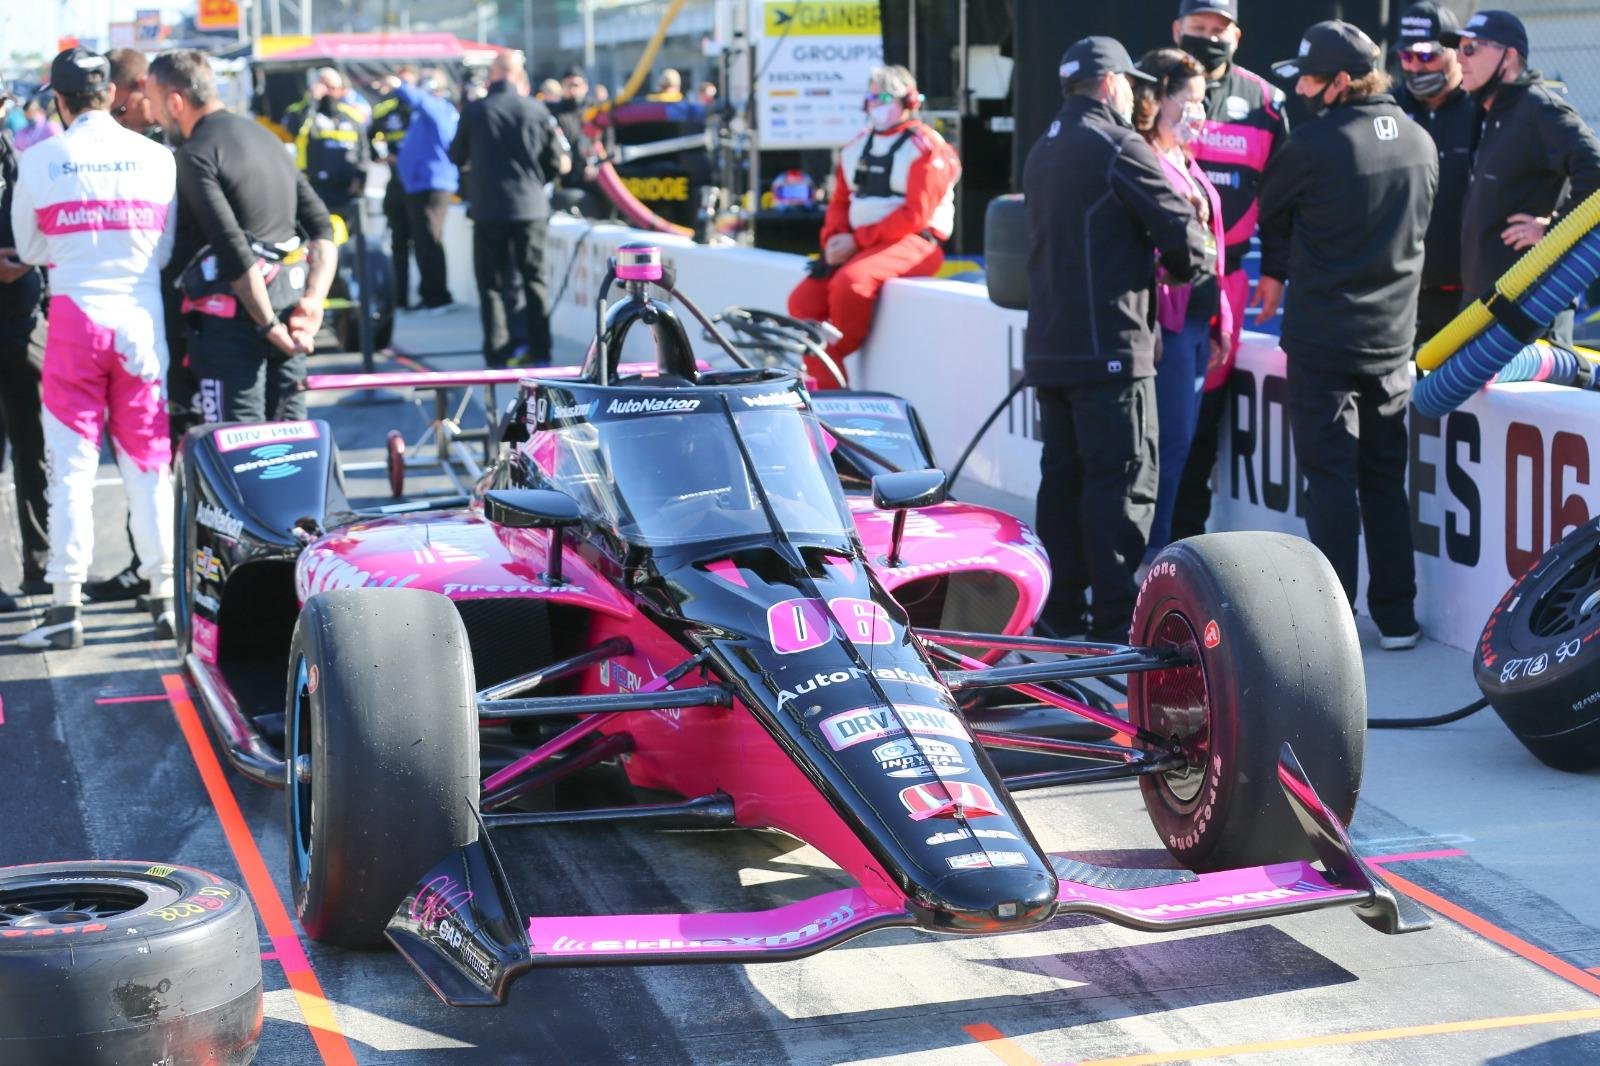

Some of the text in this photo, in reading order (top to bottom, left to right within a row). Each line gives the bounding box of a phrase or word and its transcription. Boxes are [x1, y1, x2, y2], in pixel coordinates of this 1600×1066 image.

[55, 205, 154, 228] AutoNation
[606, 397, 700, 414] AutoNation
[226, 432, 261, 445] DRV
[766, 597, 896, 655] 06
[835, 710, 954, 739] DRV PNK
[881, 754, 965, 770] INDYCAR
